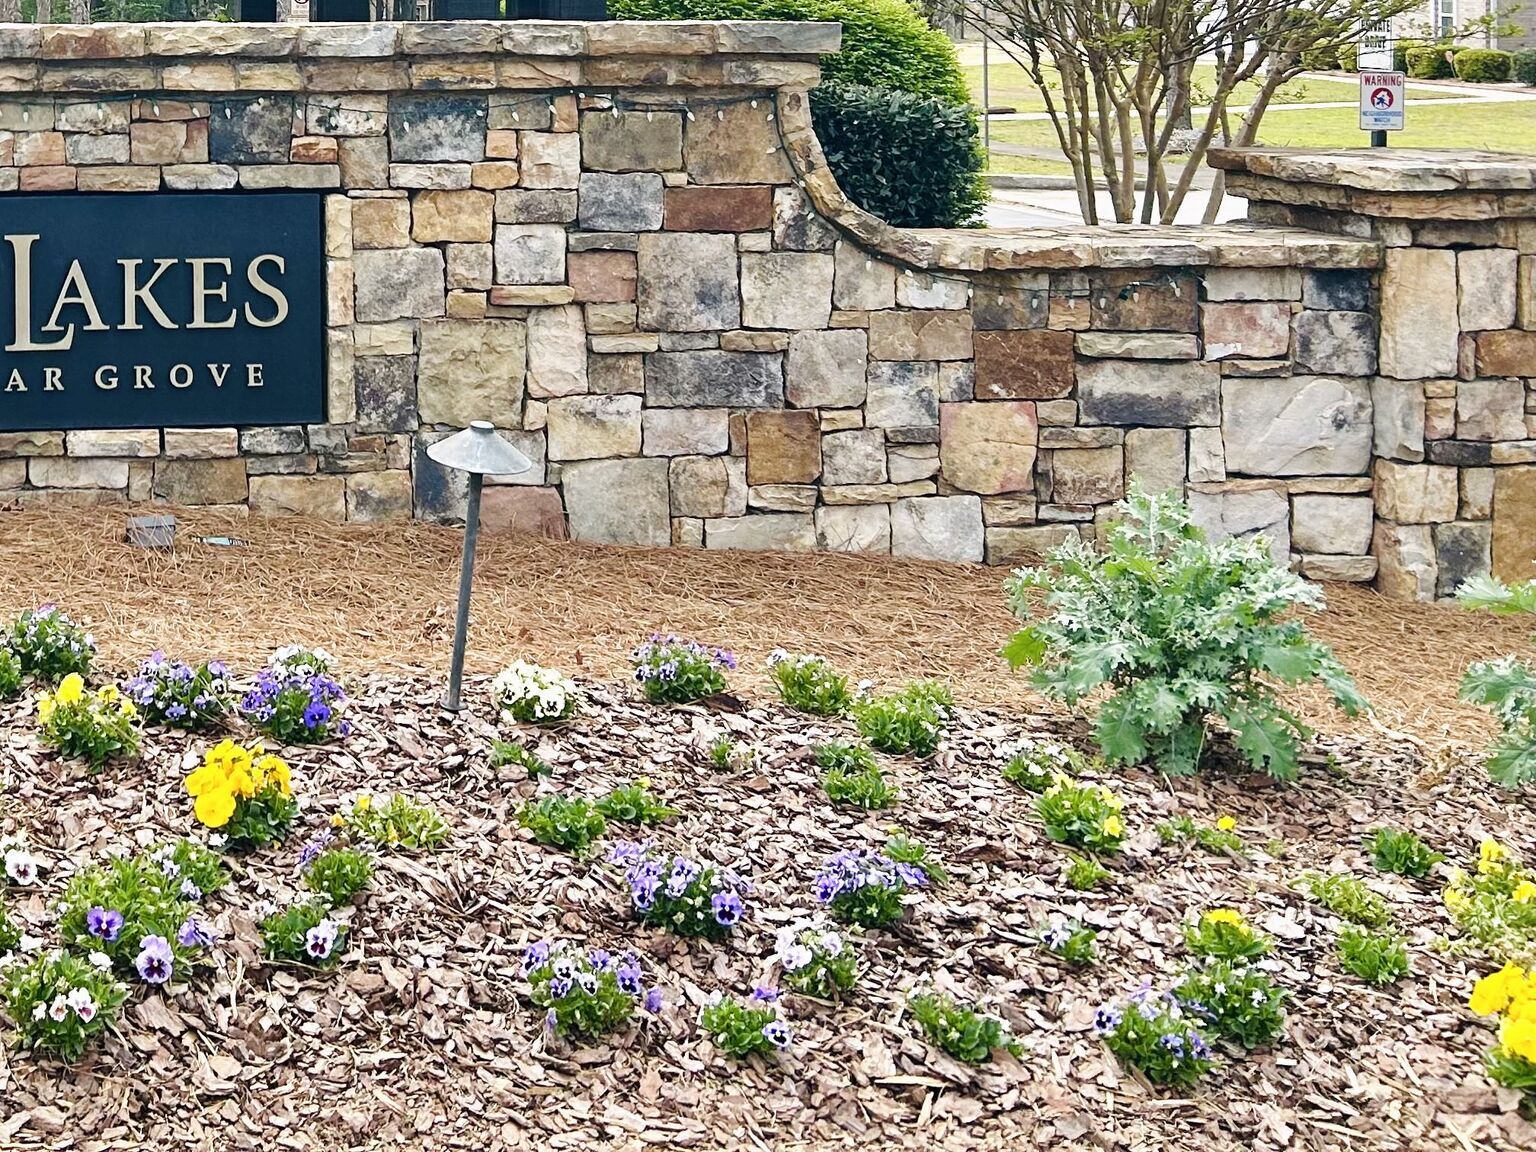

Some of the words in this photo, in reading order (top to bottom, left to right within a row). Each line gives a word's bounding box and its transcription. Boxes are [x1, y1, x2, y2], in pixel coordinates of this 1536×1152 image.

[1364, 75, 1402, 87] WARNING
[4, 233, 289, 352] LAKES
[94, 363, 265, 390] GROVE
